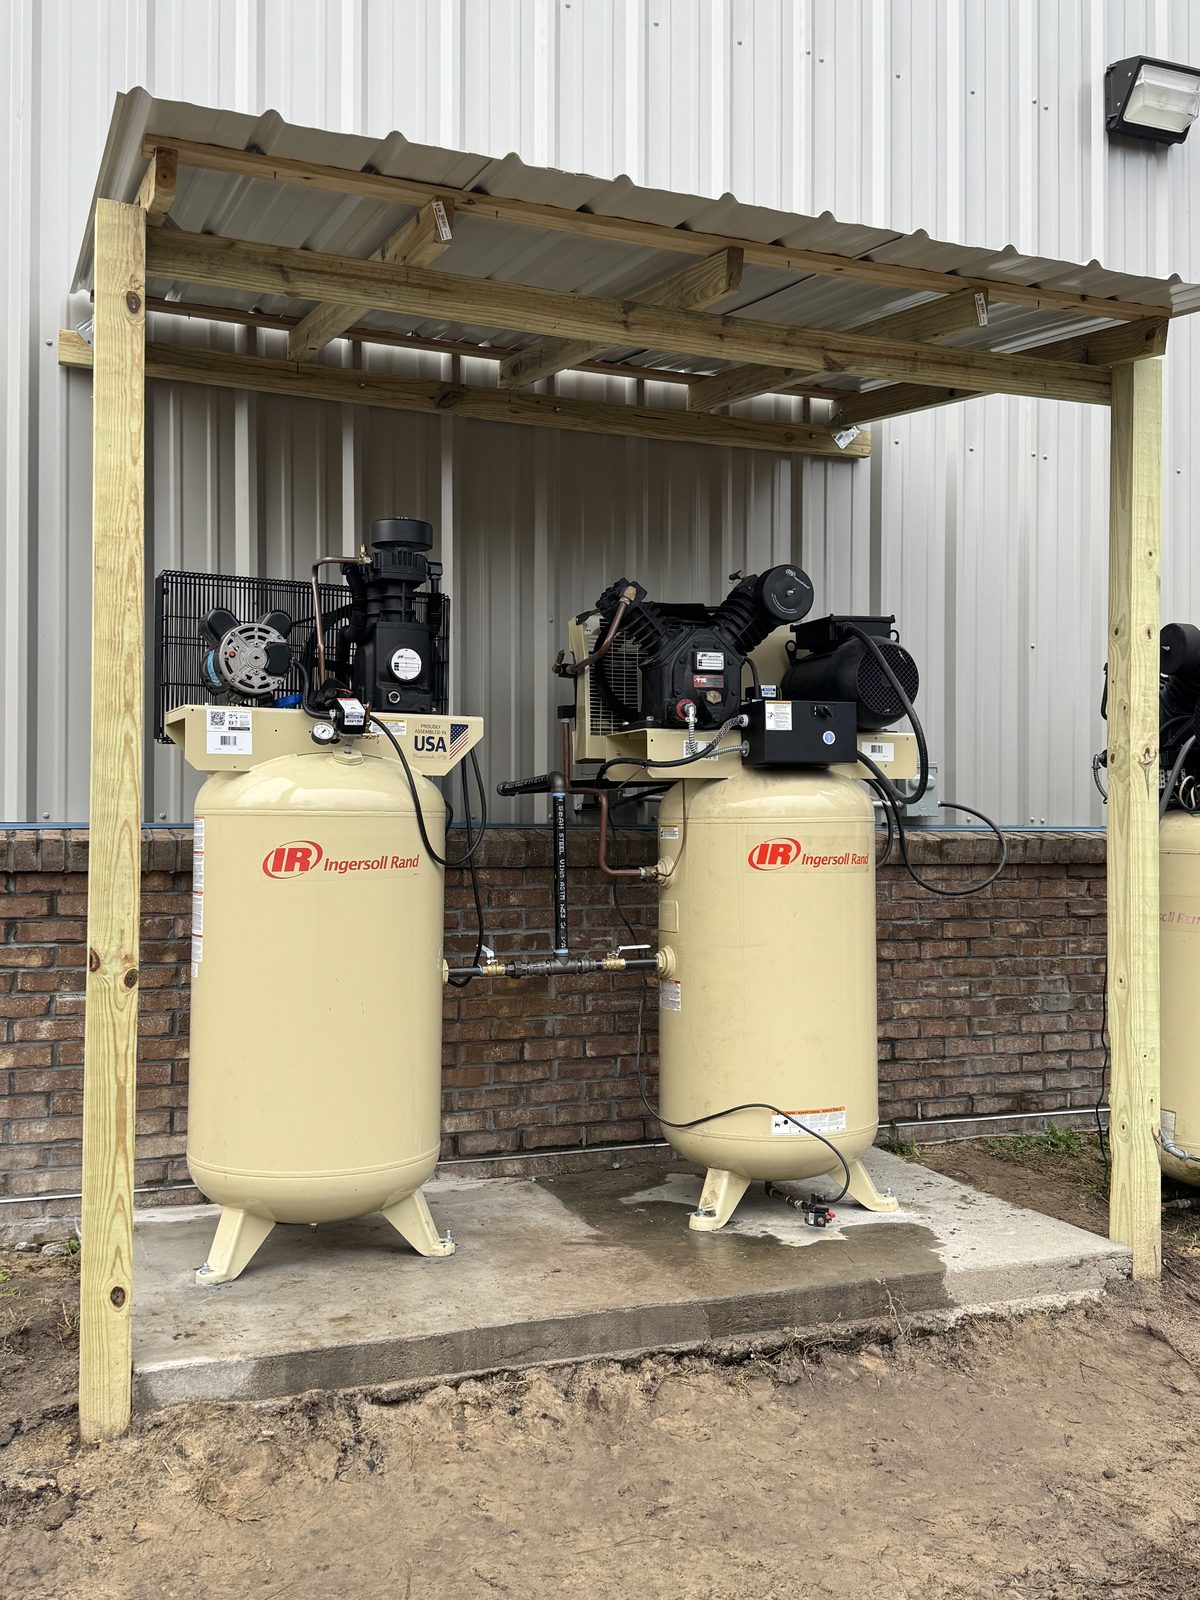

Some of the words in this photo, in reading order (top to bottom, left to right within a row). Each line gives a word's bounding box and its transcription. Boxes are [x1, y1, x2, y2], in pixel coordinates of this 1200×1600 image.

[414, 736, 447, 752] USA
[271, 848, 313, 872] IR
[323, 856, 389, 874] Ingersoll
[390, 854, 420, 869] Rand
[756, 843, 793, 865] IR
[801, 852, 850, 868] Ingersoll
[851, 853, 869, 865] Rand
